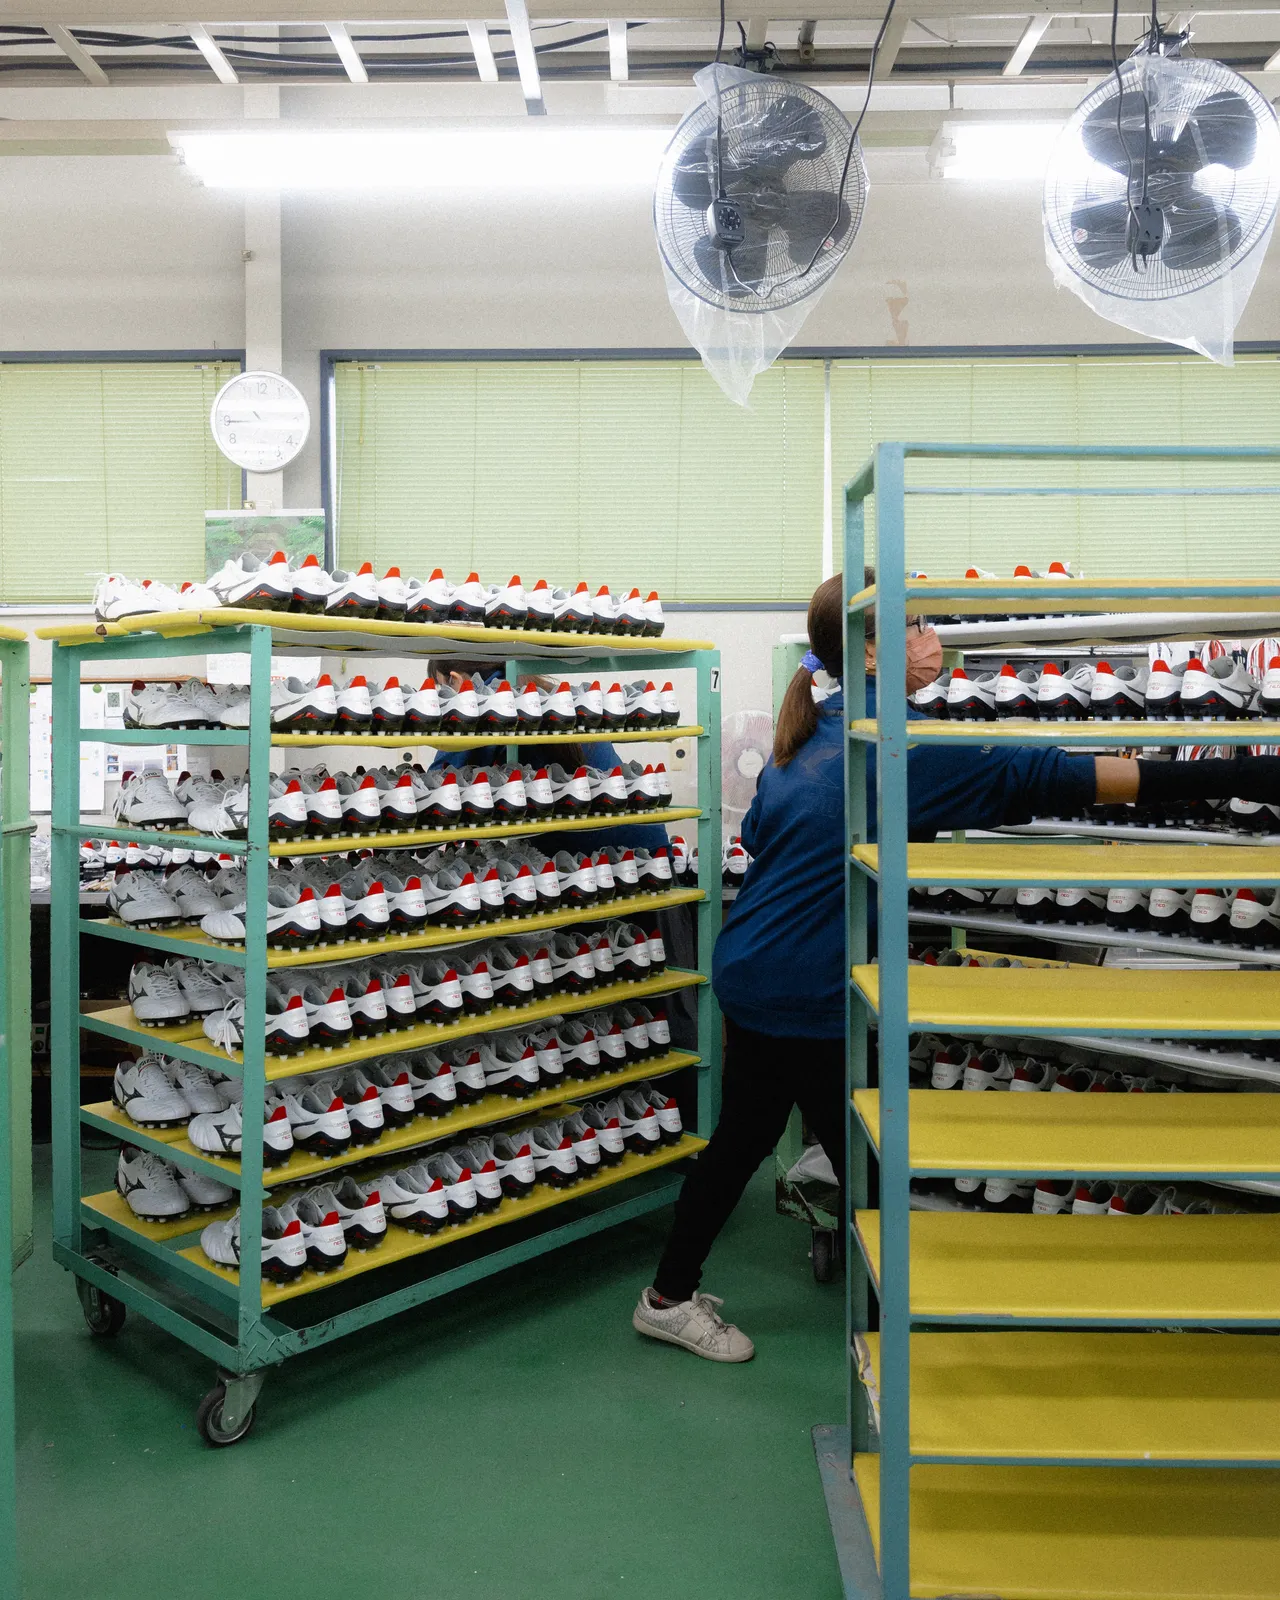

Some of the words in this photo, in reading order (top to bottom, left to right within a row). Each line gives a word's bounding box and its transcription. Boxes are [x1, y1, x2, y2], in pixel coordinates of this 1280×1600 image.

[256, 382, 268, 395] 12
[223, 414, 231, 426] 9
[229, 432, 237, 444] 8
[285, 434, 294, 446] 4
[711, 670, 720, 689] 7
